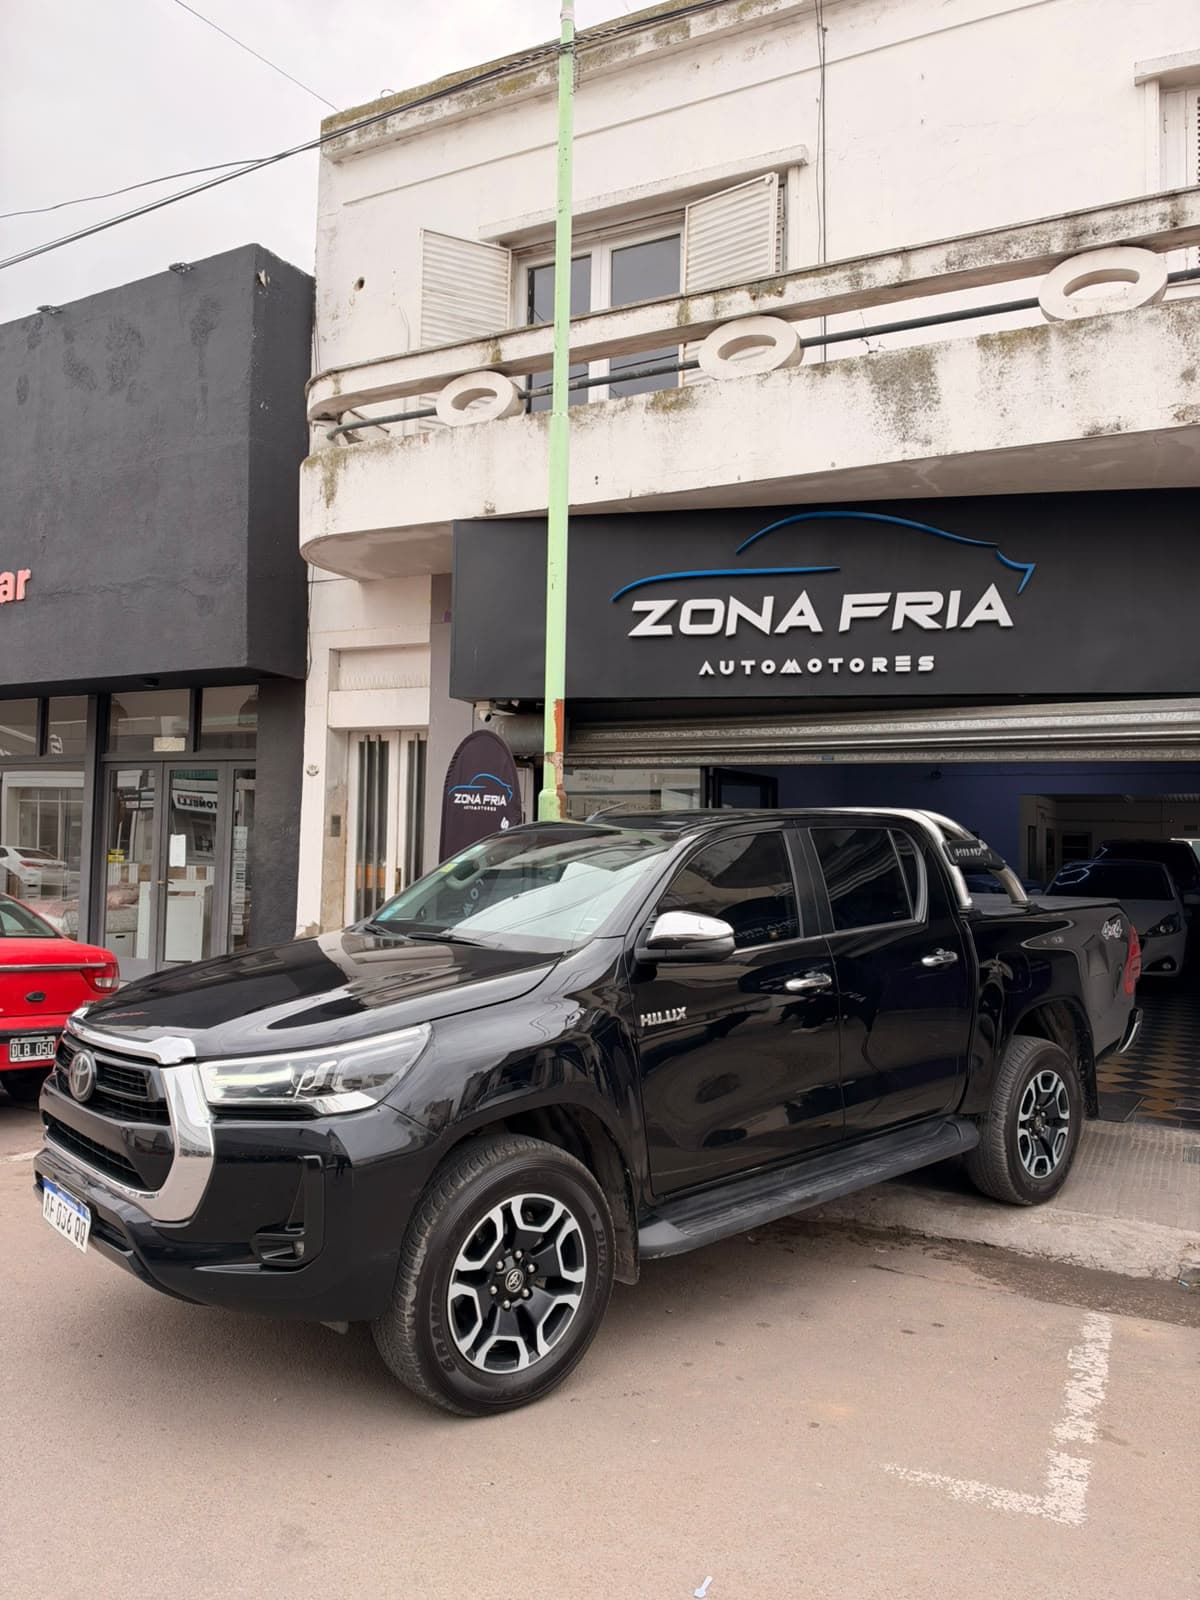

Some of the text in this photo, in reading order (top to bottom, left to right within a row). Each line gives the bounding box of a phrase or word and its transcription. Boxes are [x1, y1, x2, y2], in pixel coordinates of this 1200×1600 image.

[628, 583, 1014, 637] ZONA FRIA
[699, 655, 936, 676] AUTOMOTORES
[454, 793, 507, 806] ZONA FRIA
[640, 1006, 687, 1027] HILUX
[35, 1041, 54, 1056] 050
